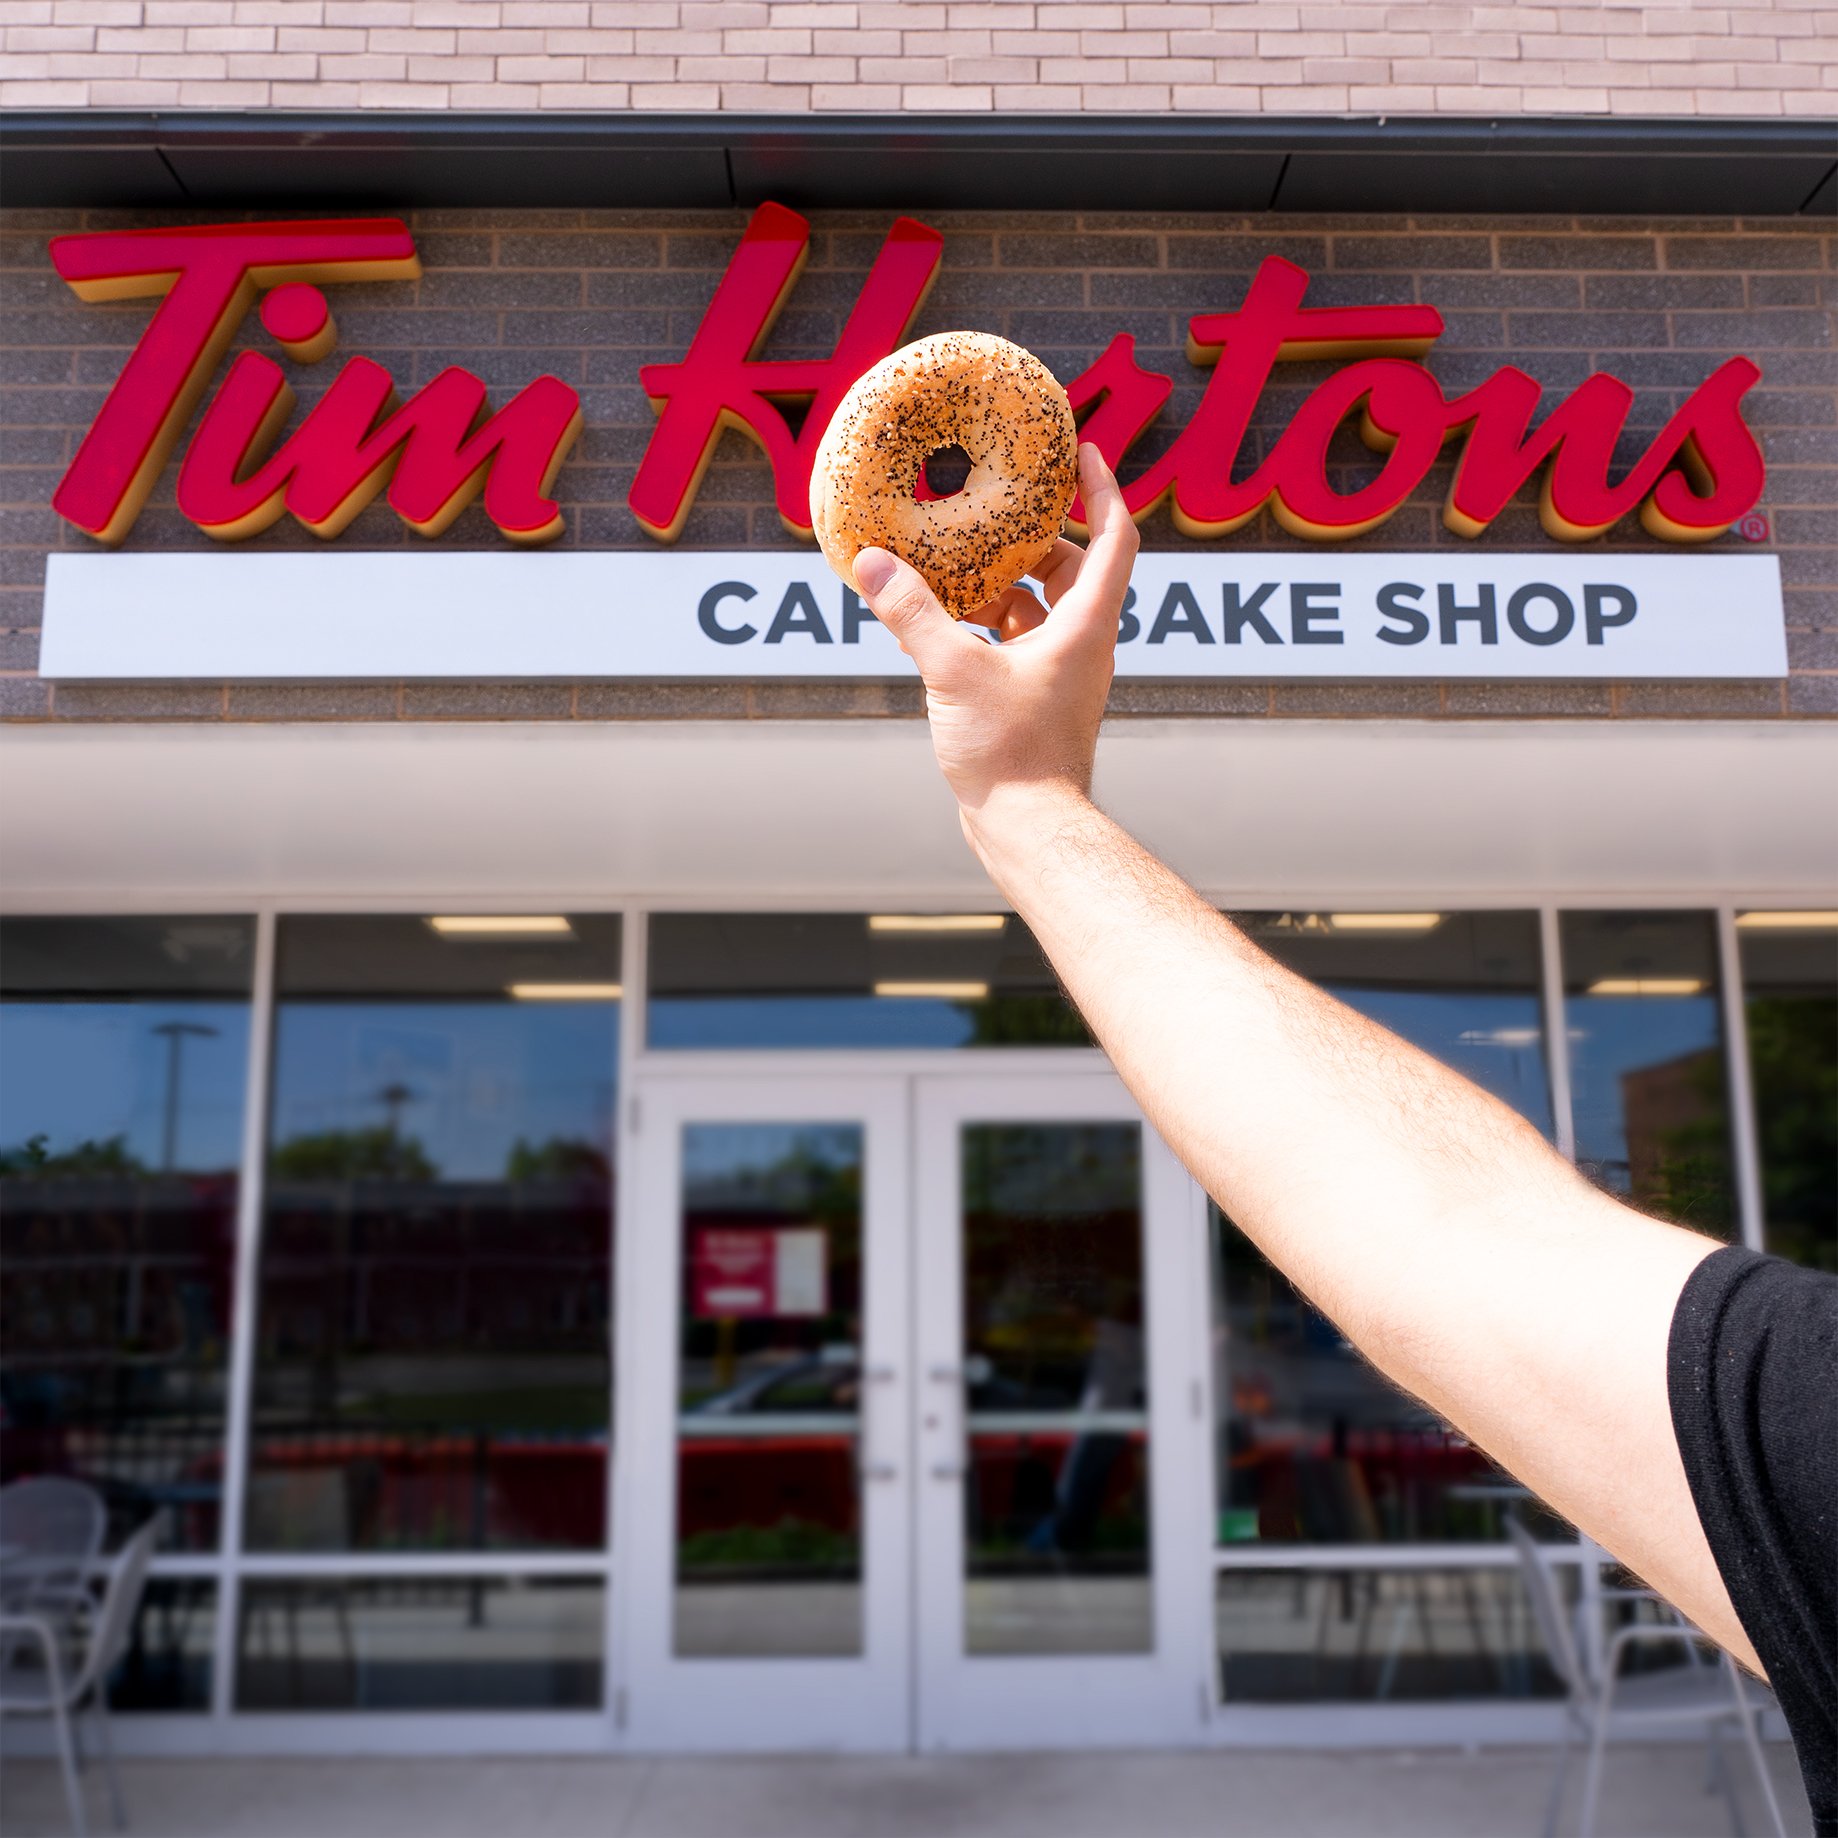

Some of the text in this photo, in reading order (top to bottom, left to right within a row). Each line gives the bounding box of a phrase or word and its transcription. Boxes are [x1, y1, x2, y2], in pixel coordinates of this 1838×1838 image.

[49, 217, 586, 545] Tim
[627, 200, 1766, 543] Hrtons
[697, 580, 884, 645] CAF
[1375, 582, 1638, 646] SHOP
